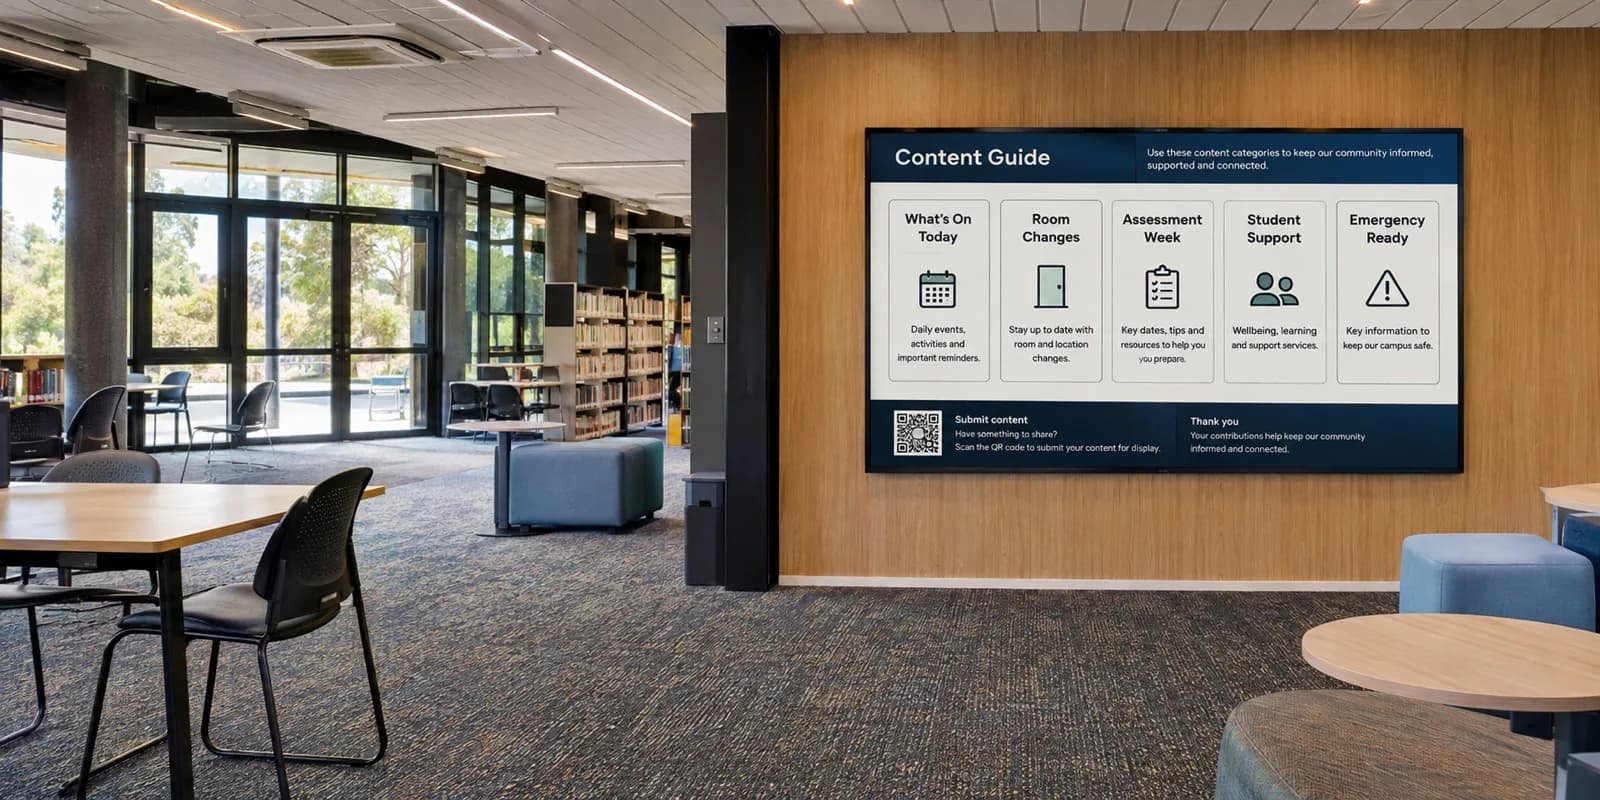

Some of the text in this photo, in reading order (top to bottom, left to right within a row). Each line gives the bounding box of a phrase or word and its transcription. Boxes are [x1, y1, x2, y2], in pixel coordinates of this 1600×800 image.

[896, 148, 1050, 166] Content Guide
[1148, 148, 1164, 157] Use
[1167, 148, 1192, 157] these
[1194, 149, 1230, 157] content
[1232, 149, 1280, 159] categories
[1282, 149, 1291, 157] to
[1294, 148, 1316, 158] keep
[1336, 148, 1387, 159] community
[1390, 148, 1433, 158] informed,
[1148, 161, 1268, 171] supported and connected.
[953, 213, 971, 224] On
[1033, 213, 1070, 225] Room
[1123, 214, 1202, 225] Assessment
[1248, 214, 1301, 225] Student
[1350, 214, 1425, 228] Emergency
[918, 231, 958, 245] Today
[1023, 231, 1080, 245] Changes
[1144, 231, 1180, 243] Week
[1248, 231, 1301, 246] Support
[1367, 232, 1408, 246] Ready
[911, 325, 966, 335] Daily events,
[1009, 325, 1093, 336] Stay up to date with
[1122, 326, 1204, 336] Key dates, tips and
[1233, 326, 1317, 337] Wellbeing, learning
[1346, 326, 1430, 337] Key information to
[911, 340, 965, 348] activities and
[1038, 340, 1054, 348] and
[1056, 340, 1088, 349] location
[1172, 341, 1189, 351] help
[1191, 342, 1205, 350] you
[1232, 341, 1318, 351] and support services.
[1343, 341, 1364, 351] keep
[1380, 343, 1412, 351] campus
[1414, 341, 1433, 350] safe.
[898, 354, 980, 363] important reminders.
[1033, 354, 1070, 364] changes.
[1139, 356, 1186, 364] you prepare.
[956, 415, 1028, 424] Submit content
[1191, 417, 1238, 428] Thank you
[977, 430, 1019, 440] something
[1032, 430, 1057, 438] share?
[1190, 432, 1208, 440] Your
[1210, 432, 1263, 440] contributions
[1265, 432, 1282, 441] help
[1284, 432, 1303, 442] keep
[1320, 433, 1365, 442] community
[955, 442, 974, 451] Scan
[976, 443, 989, 451] the
[991, 443, 1003, 451] QR
[1005, 443, 1025, 451] code
[1037, 444, 1064, 452] submit
[1066, 445, 1084, 453] your
[1118, 444, 1129, 452] for
[1132, 444, 1160, 454] display.
[1191, 444, 1289, 454] informed and connected.
